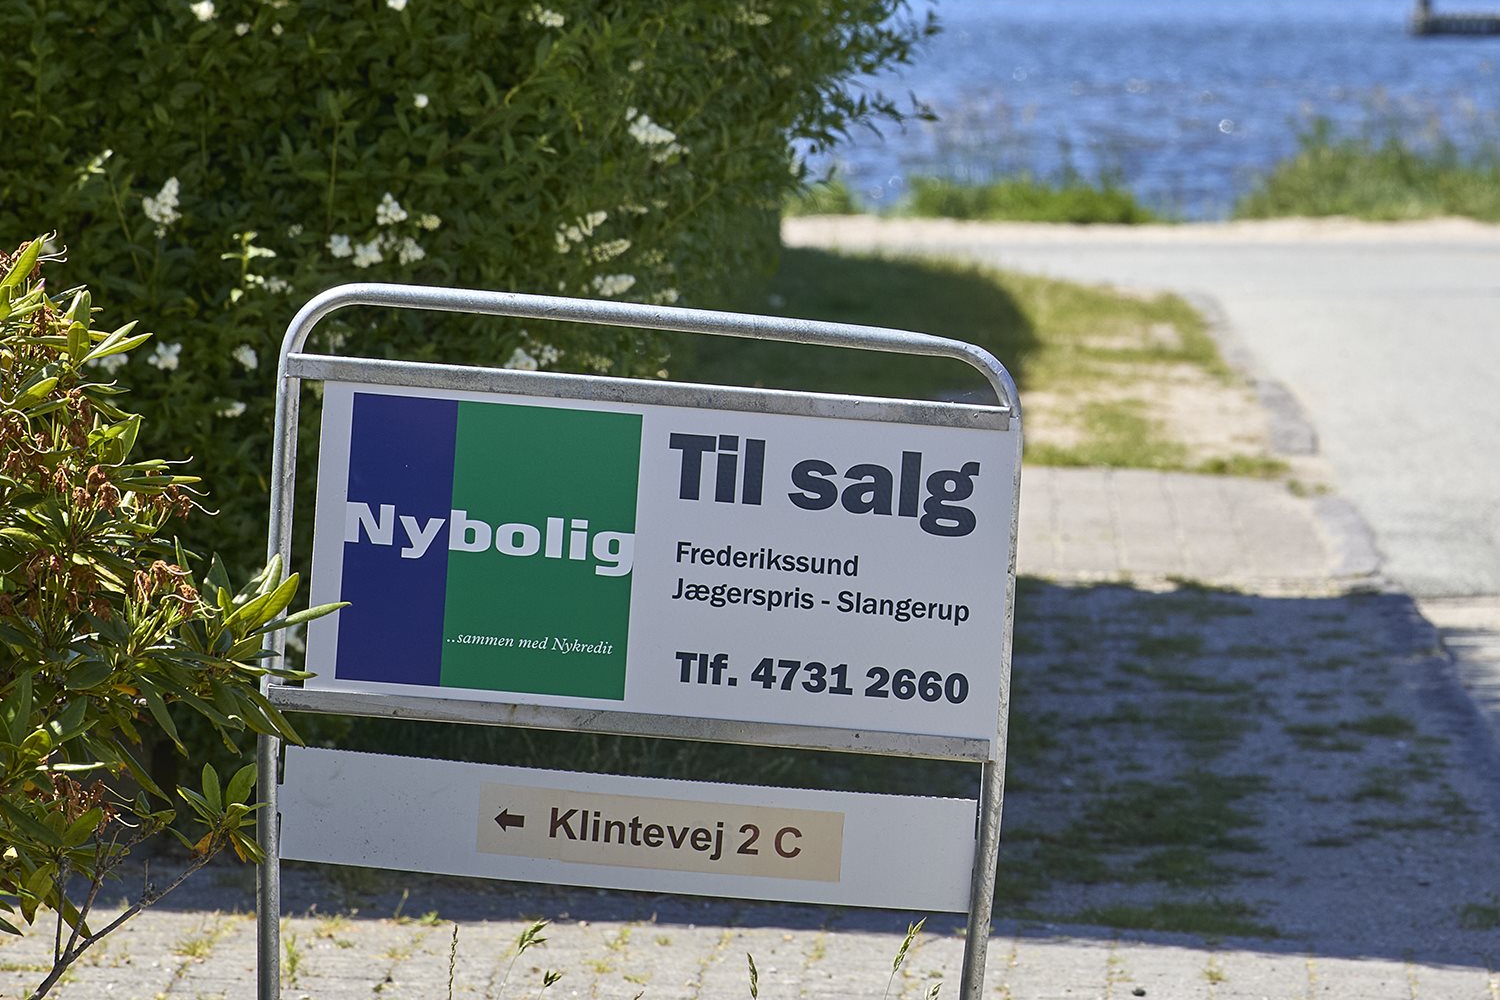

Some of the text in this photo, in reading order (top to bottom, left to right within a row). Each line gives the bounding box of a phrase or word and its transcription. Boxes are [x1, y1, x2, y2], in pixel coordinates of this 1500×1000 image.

[669, 432, 980, 537] Til salg
[344, 501, 635, 577] Nybolig
[676, 541, 859, 576] Frederikssund
[672, 578, 814, 611] Jægerspris
[836, 590, 970, 626] Slangerup
[518, 637, 548, 650] med
[551, 637, 613, 655] Nykredit
[675, 651, 969, 704] Tlf. 4731 2660
[549, 807, 803, 861] Klintevej 2 C
